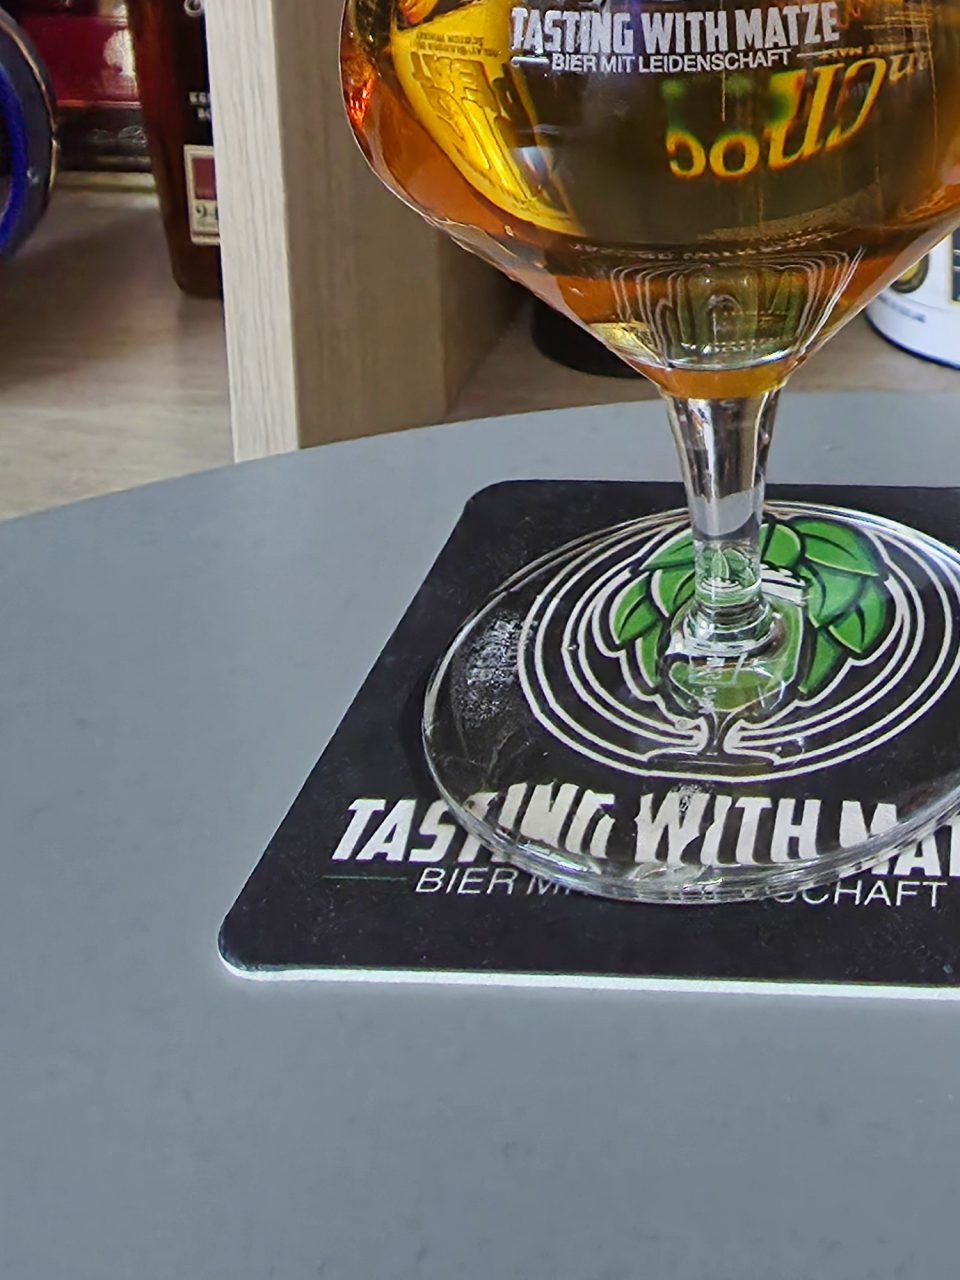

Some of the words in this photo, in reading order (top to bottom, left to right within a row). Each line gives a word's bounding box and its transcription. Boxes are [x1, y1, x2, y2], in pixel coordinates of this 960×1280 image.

[511, 6, 635, 55] TASTING
[640, 9, 729, 55] WITH
[735, 0, 841, 52] MATZE
[551, 53, 597, 73] BIER
[599, 54, 636, 74] MIT
[638, 47, 793, 73] LEIDENSCHAFT
[633, 791, 822, 867] WITH
[414, 866, 520, 896] BIER
